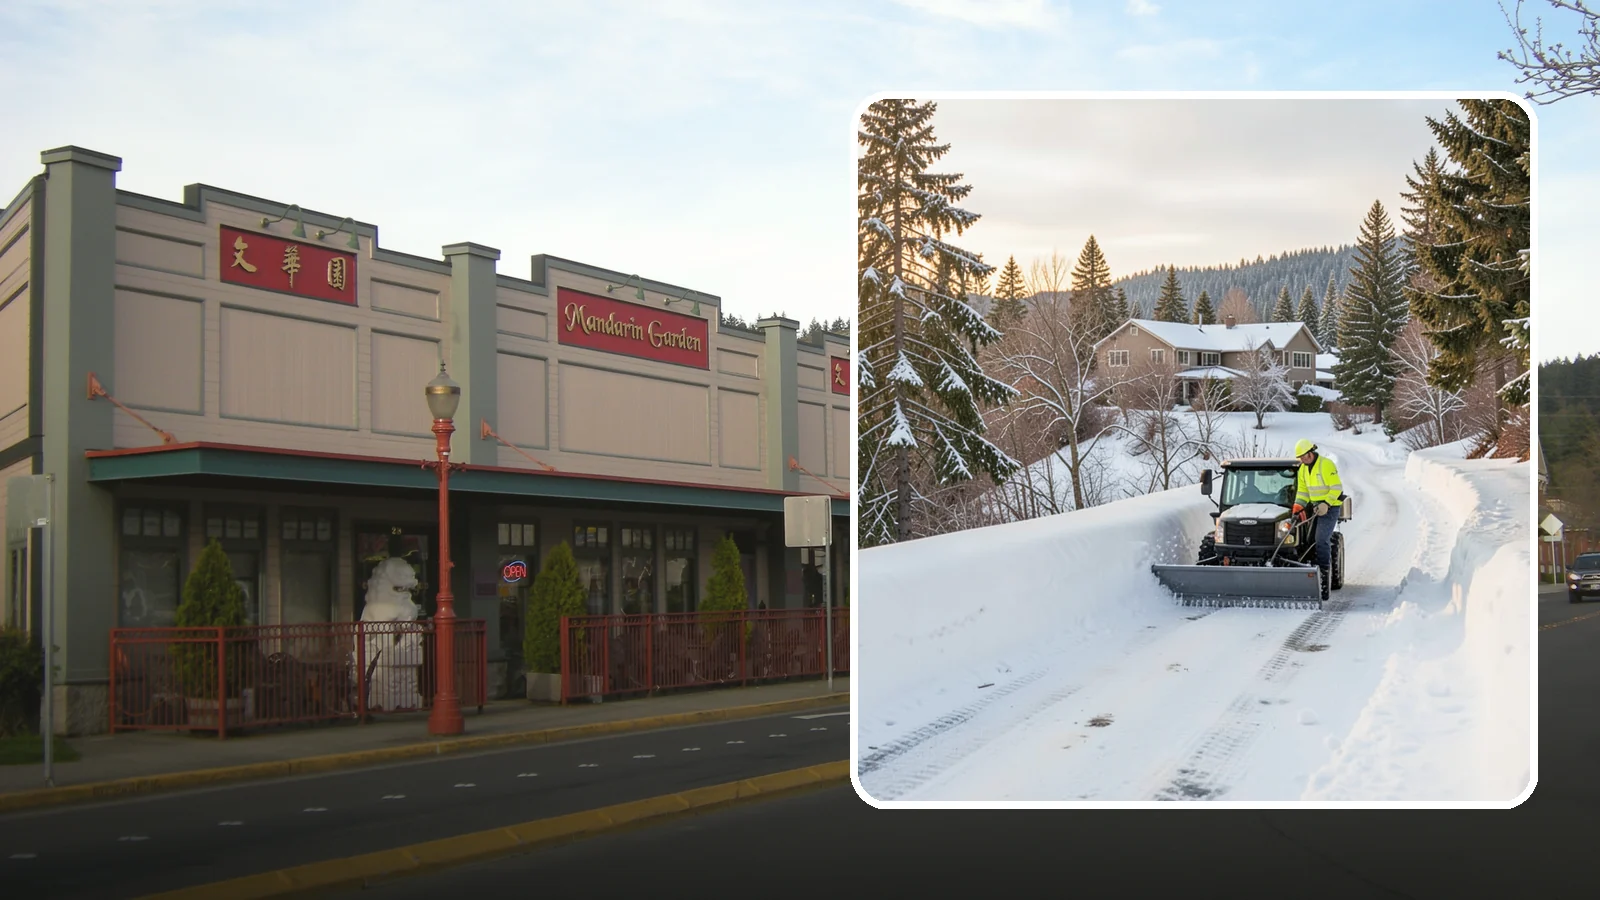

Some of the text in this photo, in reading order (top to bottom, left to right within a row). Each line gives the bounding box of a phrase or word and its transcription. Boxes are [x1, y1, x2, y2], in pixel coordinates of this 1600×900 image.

[231, 236, 346, 290] 文華園
[564, 302, 701, 352] Mandarin Garden
[835, 363, 847, 386] 文
[503, 565, 527, 578] OPEN
